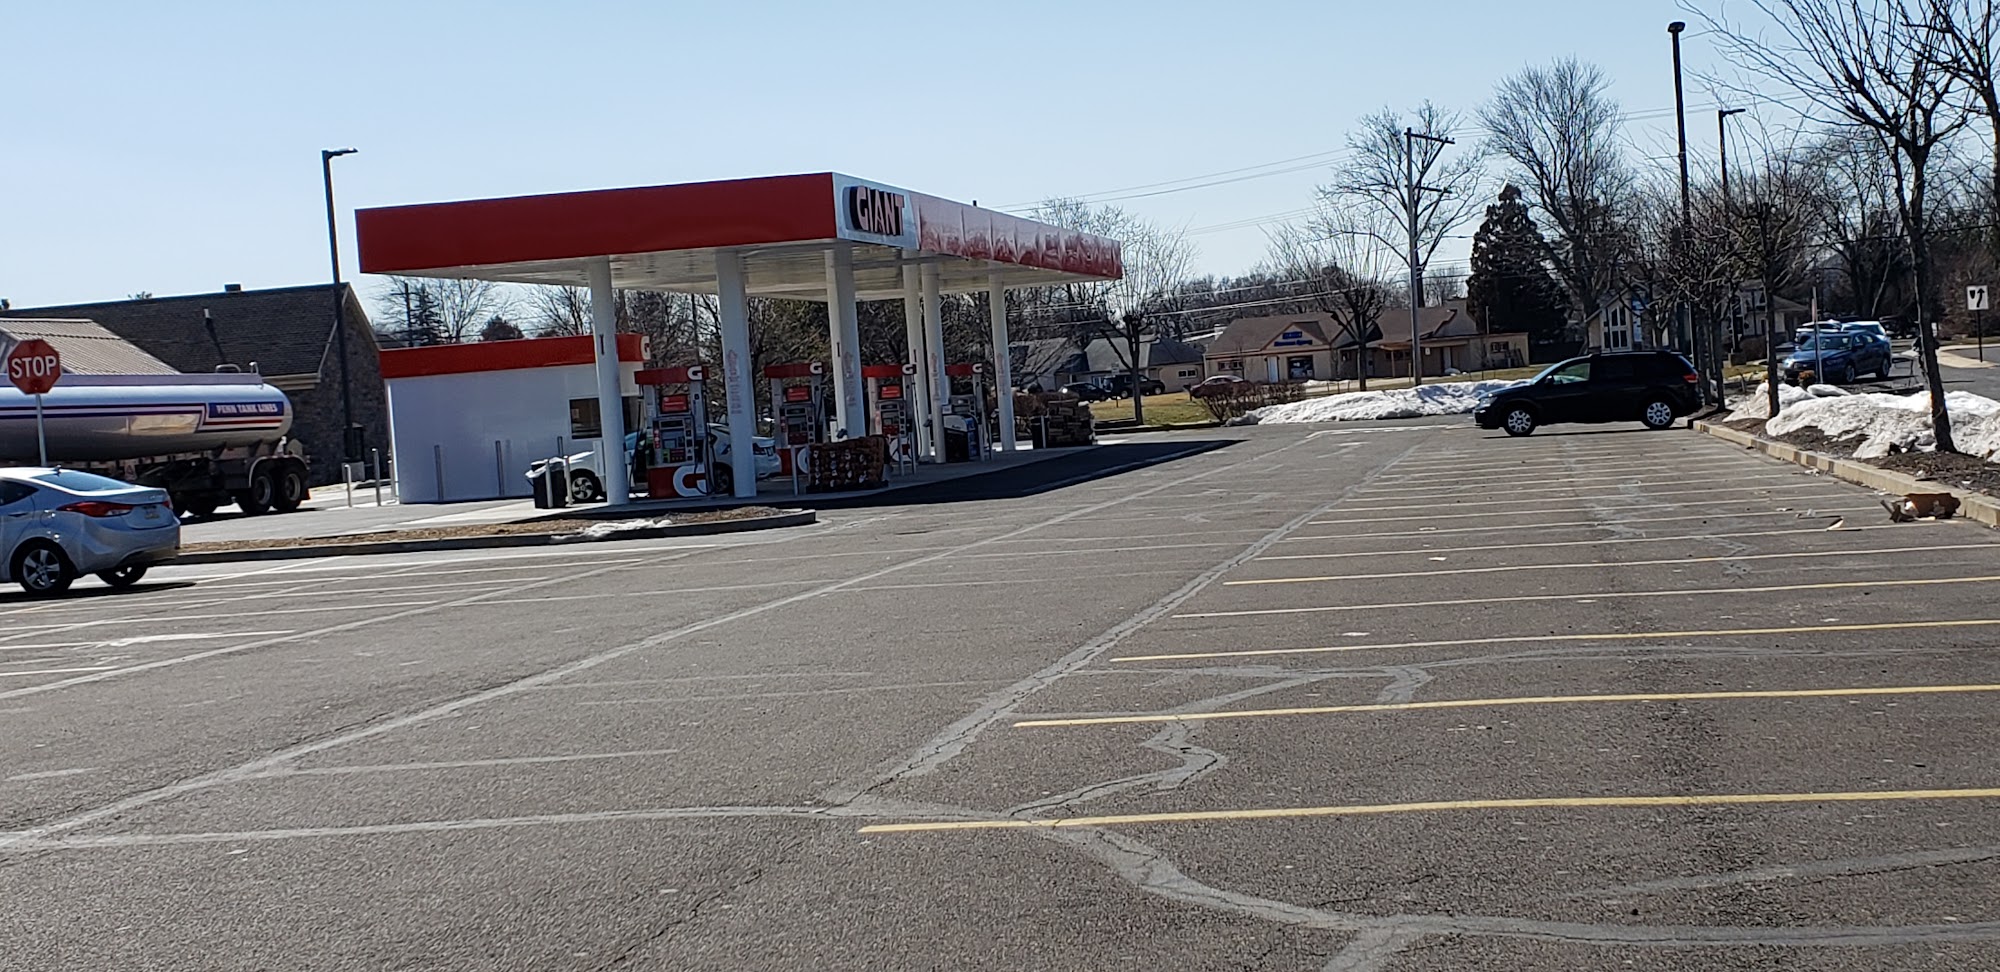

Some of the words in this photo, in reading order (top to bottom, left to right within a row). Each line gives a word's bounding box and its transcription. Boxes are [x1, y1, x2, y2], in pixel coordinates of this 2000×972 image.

[855, 186, 905, 236] GIANT
[11, 355, 57, 379] STOP
[687, 366, 703, 380] G
[810, 361, 823, 375] G
[901, 363, 914, 375] G
[972, 362, 984, 374] G
[236, 404, 258, 413] TANK
[257, 403, 278, 412] LINES
[673, 463, 707, 497] G
